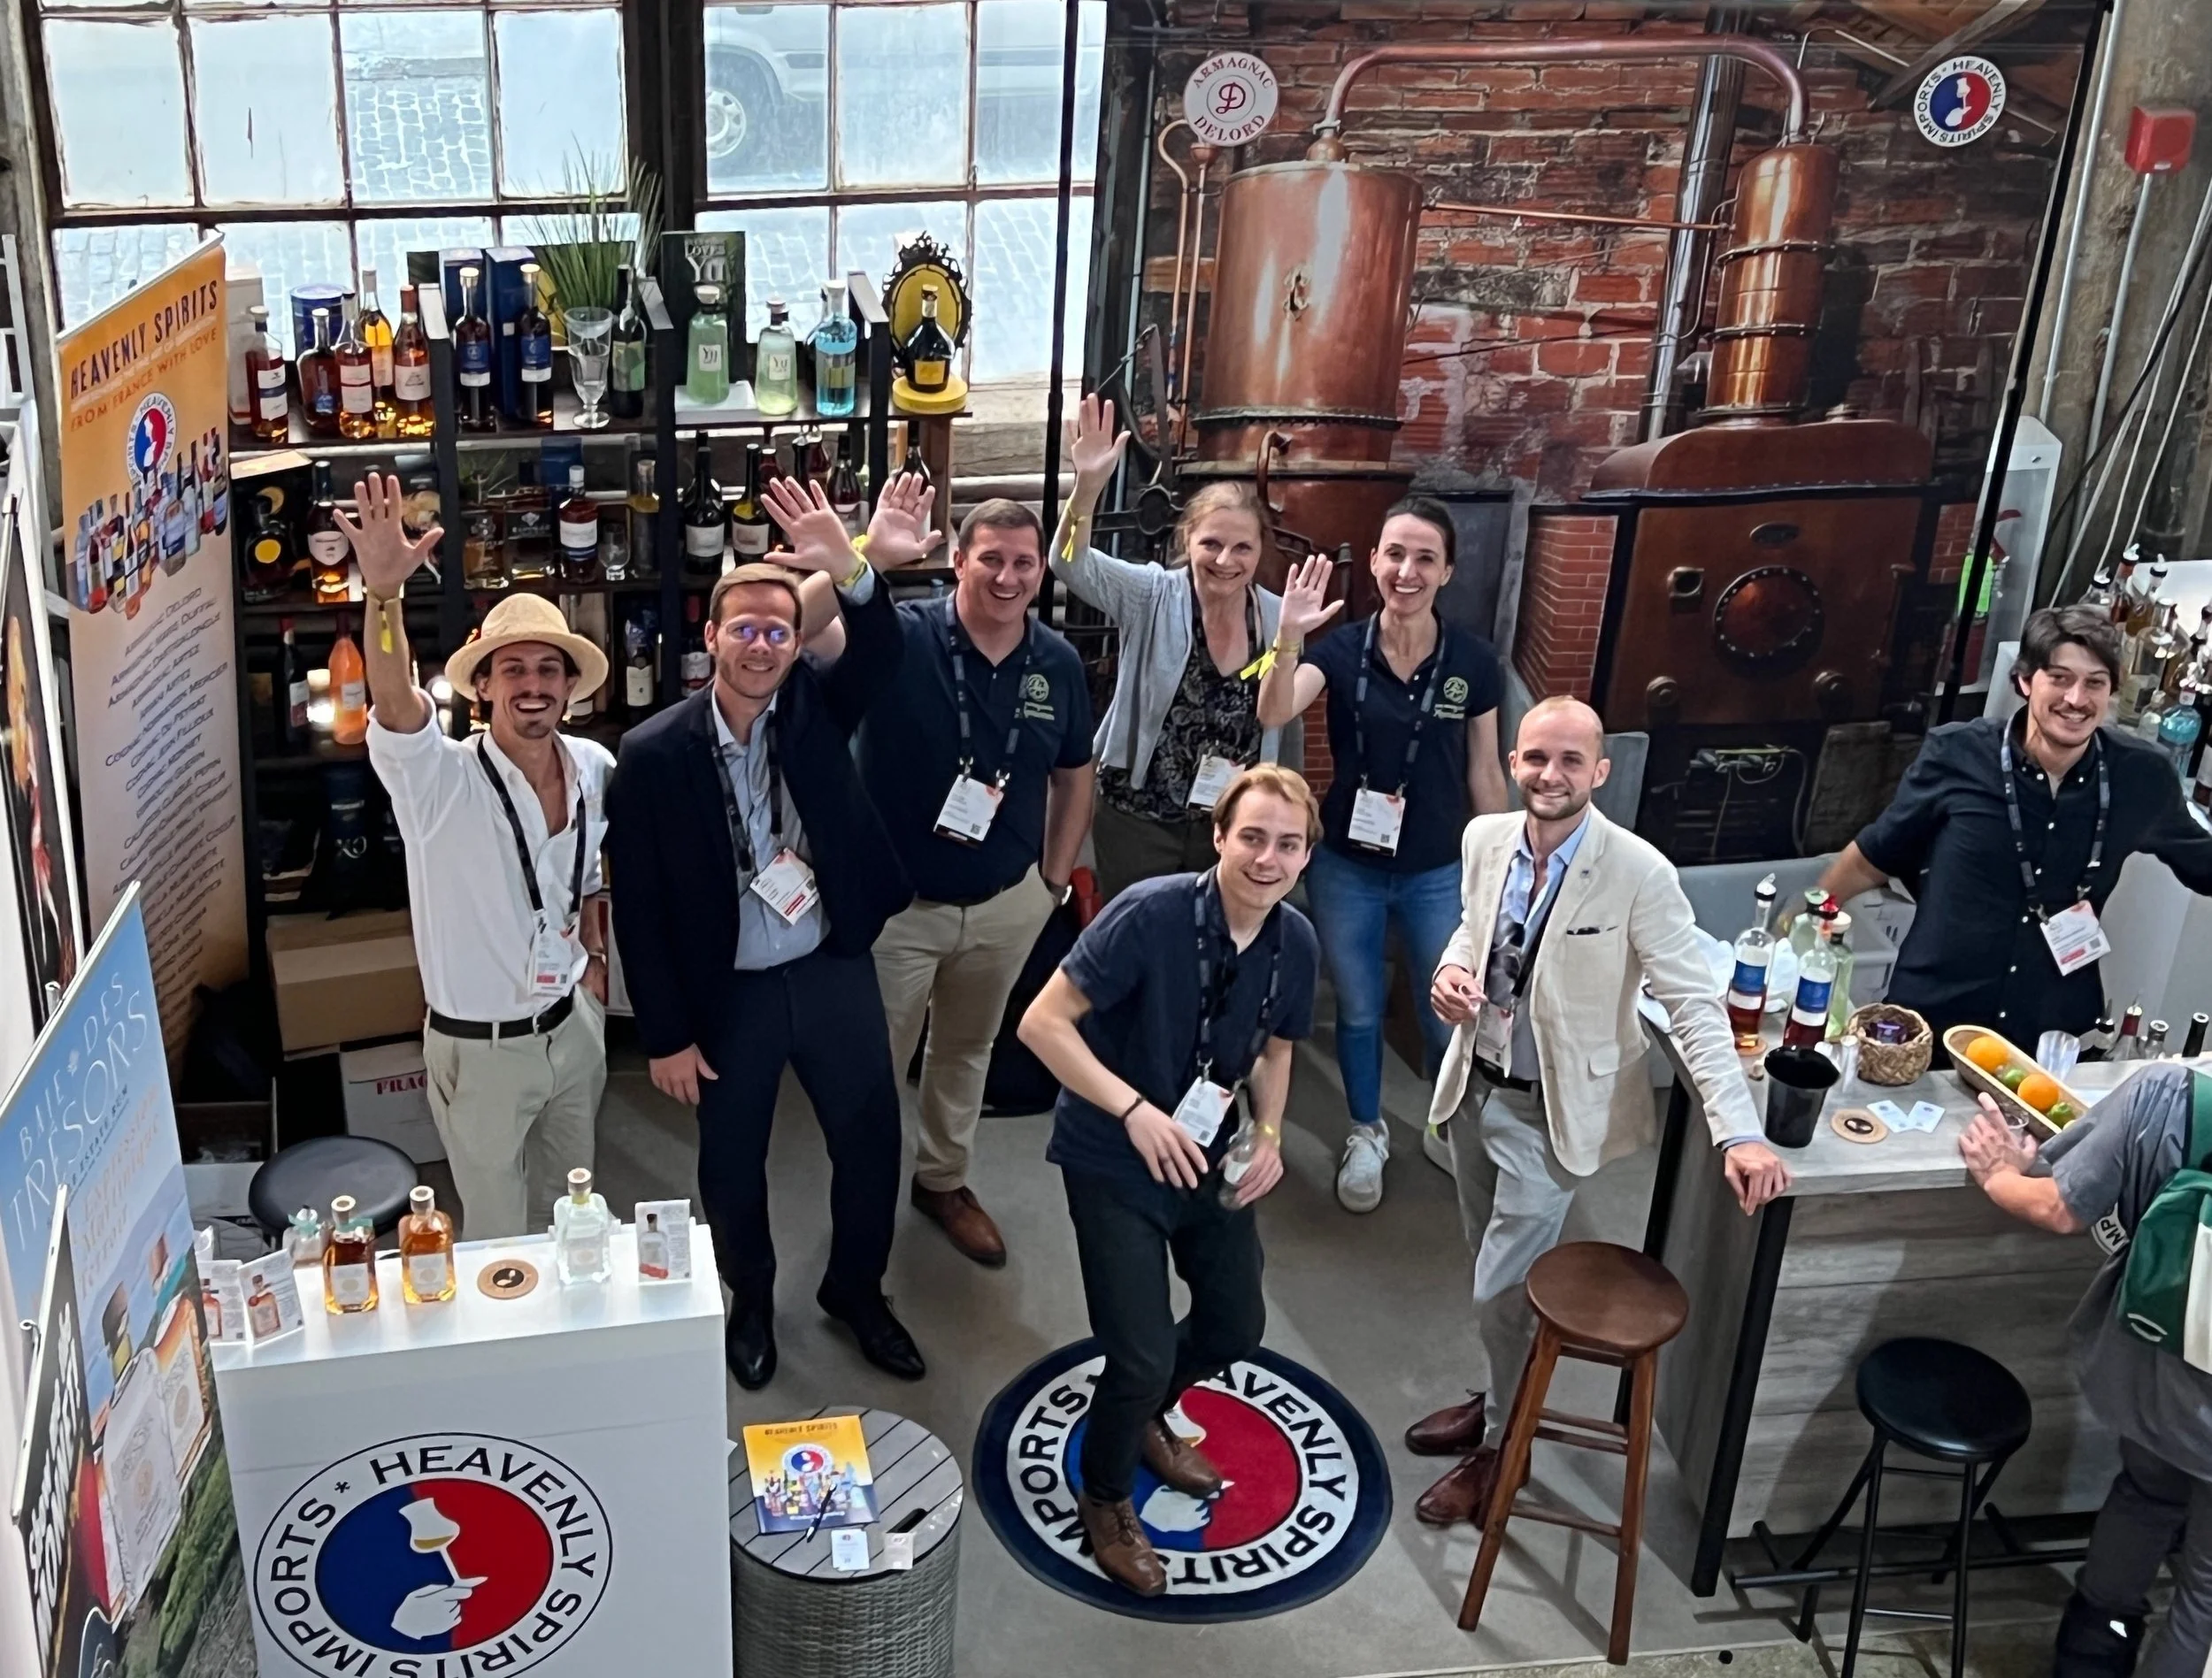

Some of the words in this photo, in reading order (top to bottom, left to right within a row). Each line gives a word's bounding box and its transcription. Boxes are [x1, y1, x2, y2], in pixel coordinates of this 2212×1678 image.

[1193, 57, 1274, 88] ARMAGNAC
[1917, 72, 1942, 138] IMPORTS
[1953, 60, 2003, 111] HEAVENLY
[1194, 115, 1265, 142] DELORD
[71, 323, 146, 399] HEAVENLY
[154, 280, 218, 343] SPIRITS
[71, 404, 108, 432] FROM
[112, 367, 154, 409] FRANCE
[157, 351, 186, 375] WITH
[189, 328, 217, 354] LOVE
[83, 972, 123, 1054] DES
[376, 1074, 427, 1095] FRAG
[1019, 1384, 1094, 1557] MPORTS
[1210, 1365, 1348, 1501] AVENLY
[370, 1445, 595, 1580] HEAVENLY
[271, 1497, 378, 1678] IMPORTS
